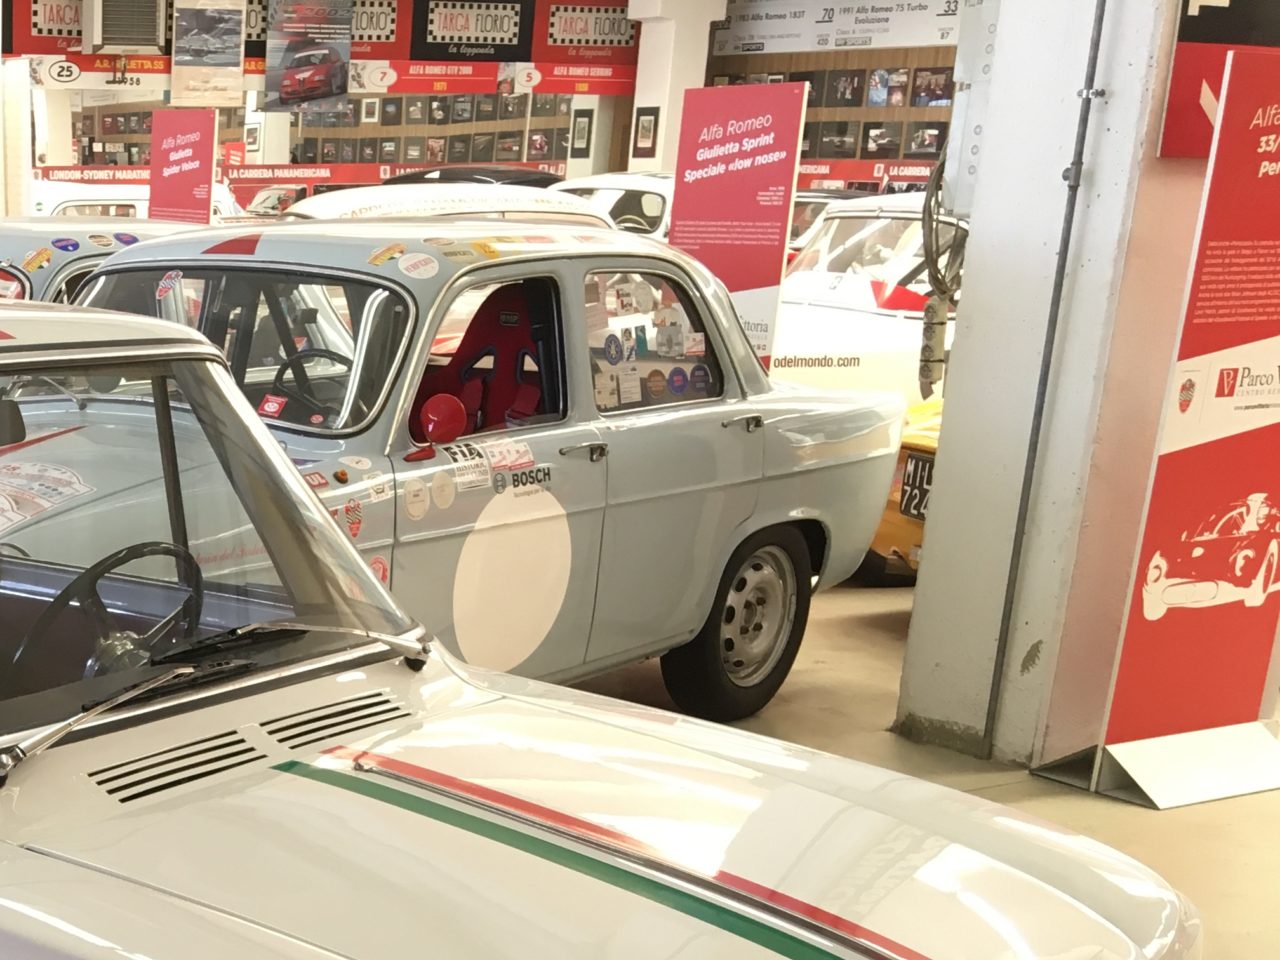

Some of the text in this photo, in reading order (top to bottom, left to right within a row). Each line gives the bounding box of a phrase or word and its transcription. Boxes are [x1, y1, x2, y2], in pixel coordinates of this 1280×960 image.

[42, 4, 81, 25] TARGA
[821, 8, 835, 20] 70
[856, 6, 869, 15] Alfa
[871, 5, 893, 14] Romeo
[907, 3, 928, 12] Turbo
[943, 0, 959, 14] 33
[437, 12, 511, 33] TARGA FLORIO
[765, 12, 787, 20] Romeo
[558, 16, 628, 36] TARGA FLORIO
[56, 65, 73, 78] 25
[379, 71, 388, 82] 7
[525, 72, 534, 82] 5
[698, 114, 772, 144] Alfa Romeo
[161, 131, 201, 150] Alfa Romeo
[696, 132, 775, 162] Giulietta Sprint
[49, 170, 151, 180] LONDON-SYDNEY MARATHO
[229, 168, 331, 179] LA CARRERA PANAMERICANA
[683, 164, 726, 184] Speciale
[743, 319, 769, 333] ttoria
[1239, 366, 1274, 388] Parco
[442, 442, 485, 463] FIA
[512, 467, 552, 488] BOSCH
